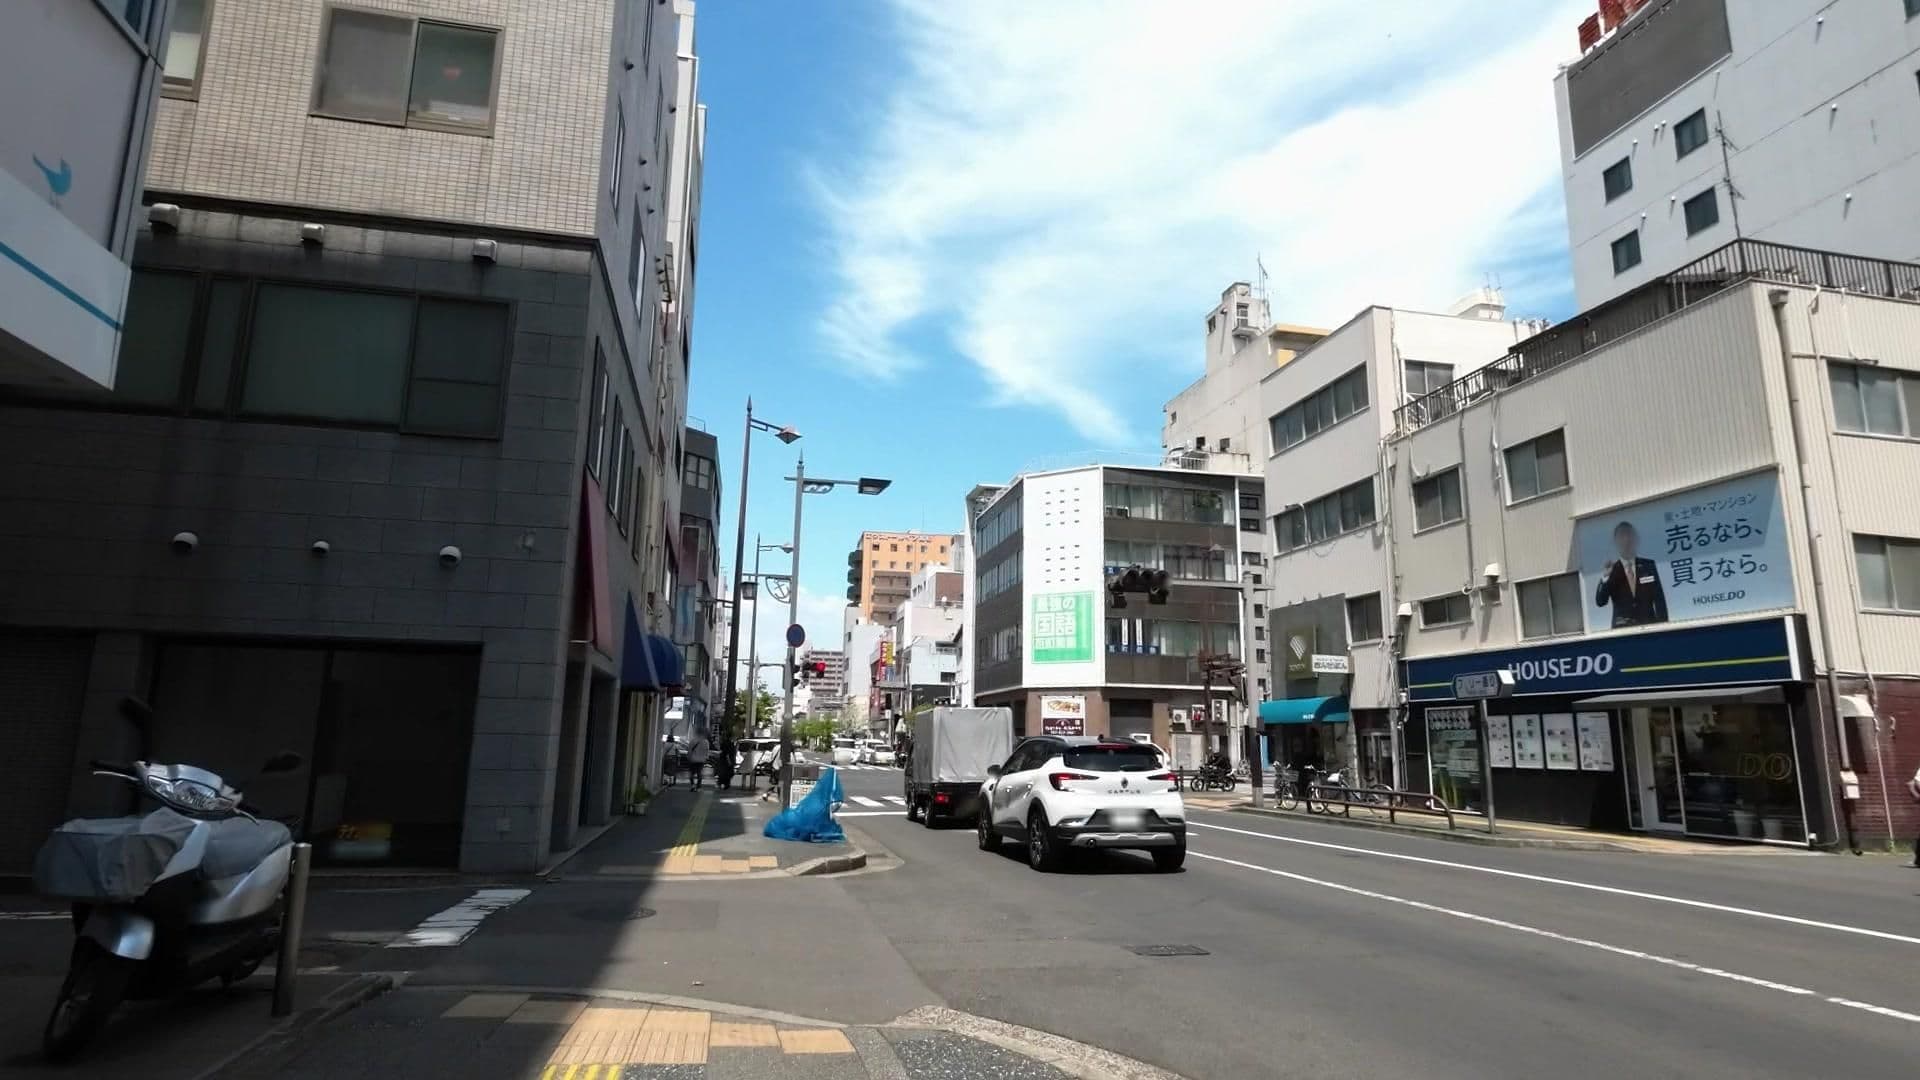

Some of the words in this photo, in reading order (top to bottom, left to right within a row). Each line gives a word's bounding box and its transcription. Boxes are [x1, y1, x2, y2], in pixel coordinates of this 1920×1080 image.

[1665, 518, 1763, 554] 売るなら、
[1671, 554, 1768, 588] 買うなら。
